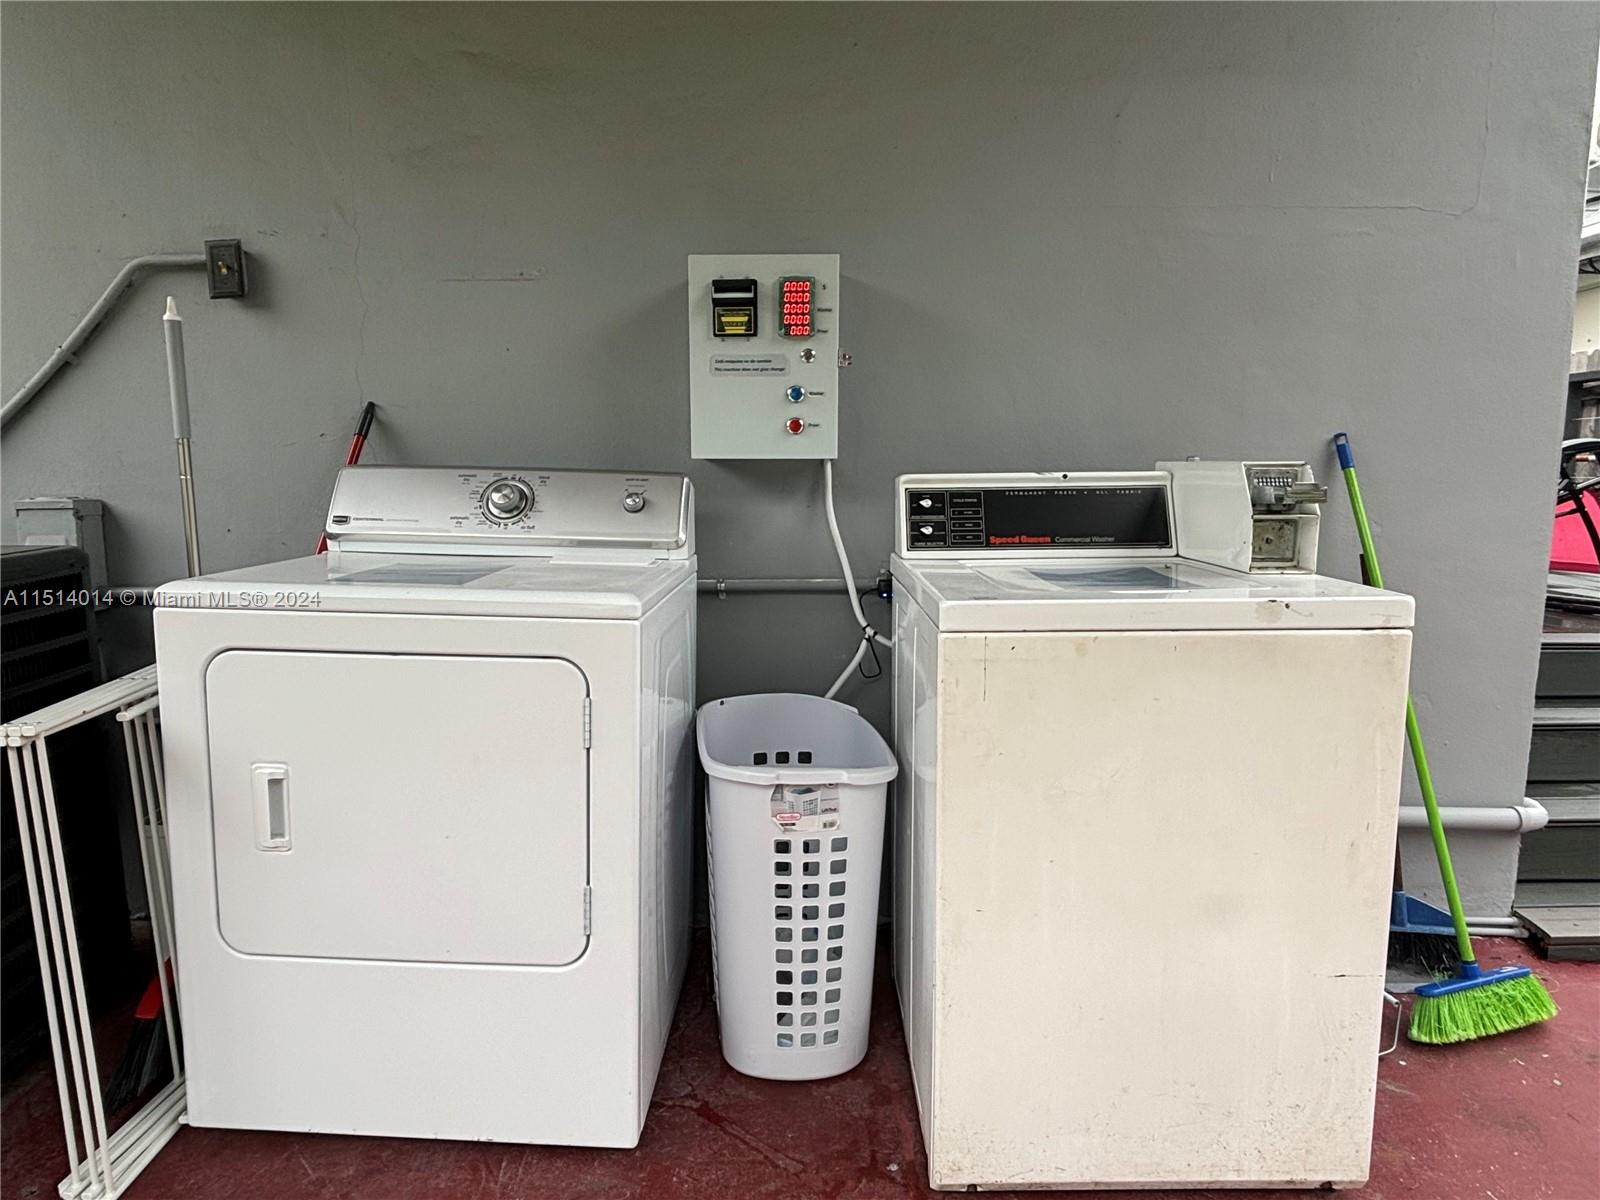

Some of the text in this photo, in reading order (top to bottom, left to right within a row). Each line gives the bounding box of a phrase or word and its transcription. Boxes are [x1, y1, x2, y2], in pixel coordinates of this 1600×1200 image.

[989, 535, 1020, 545] Speed
[1021, 535, 1051, 544] Queen
[1090, 535, 1115, 543] Washer
